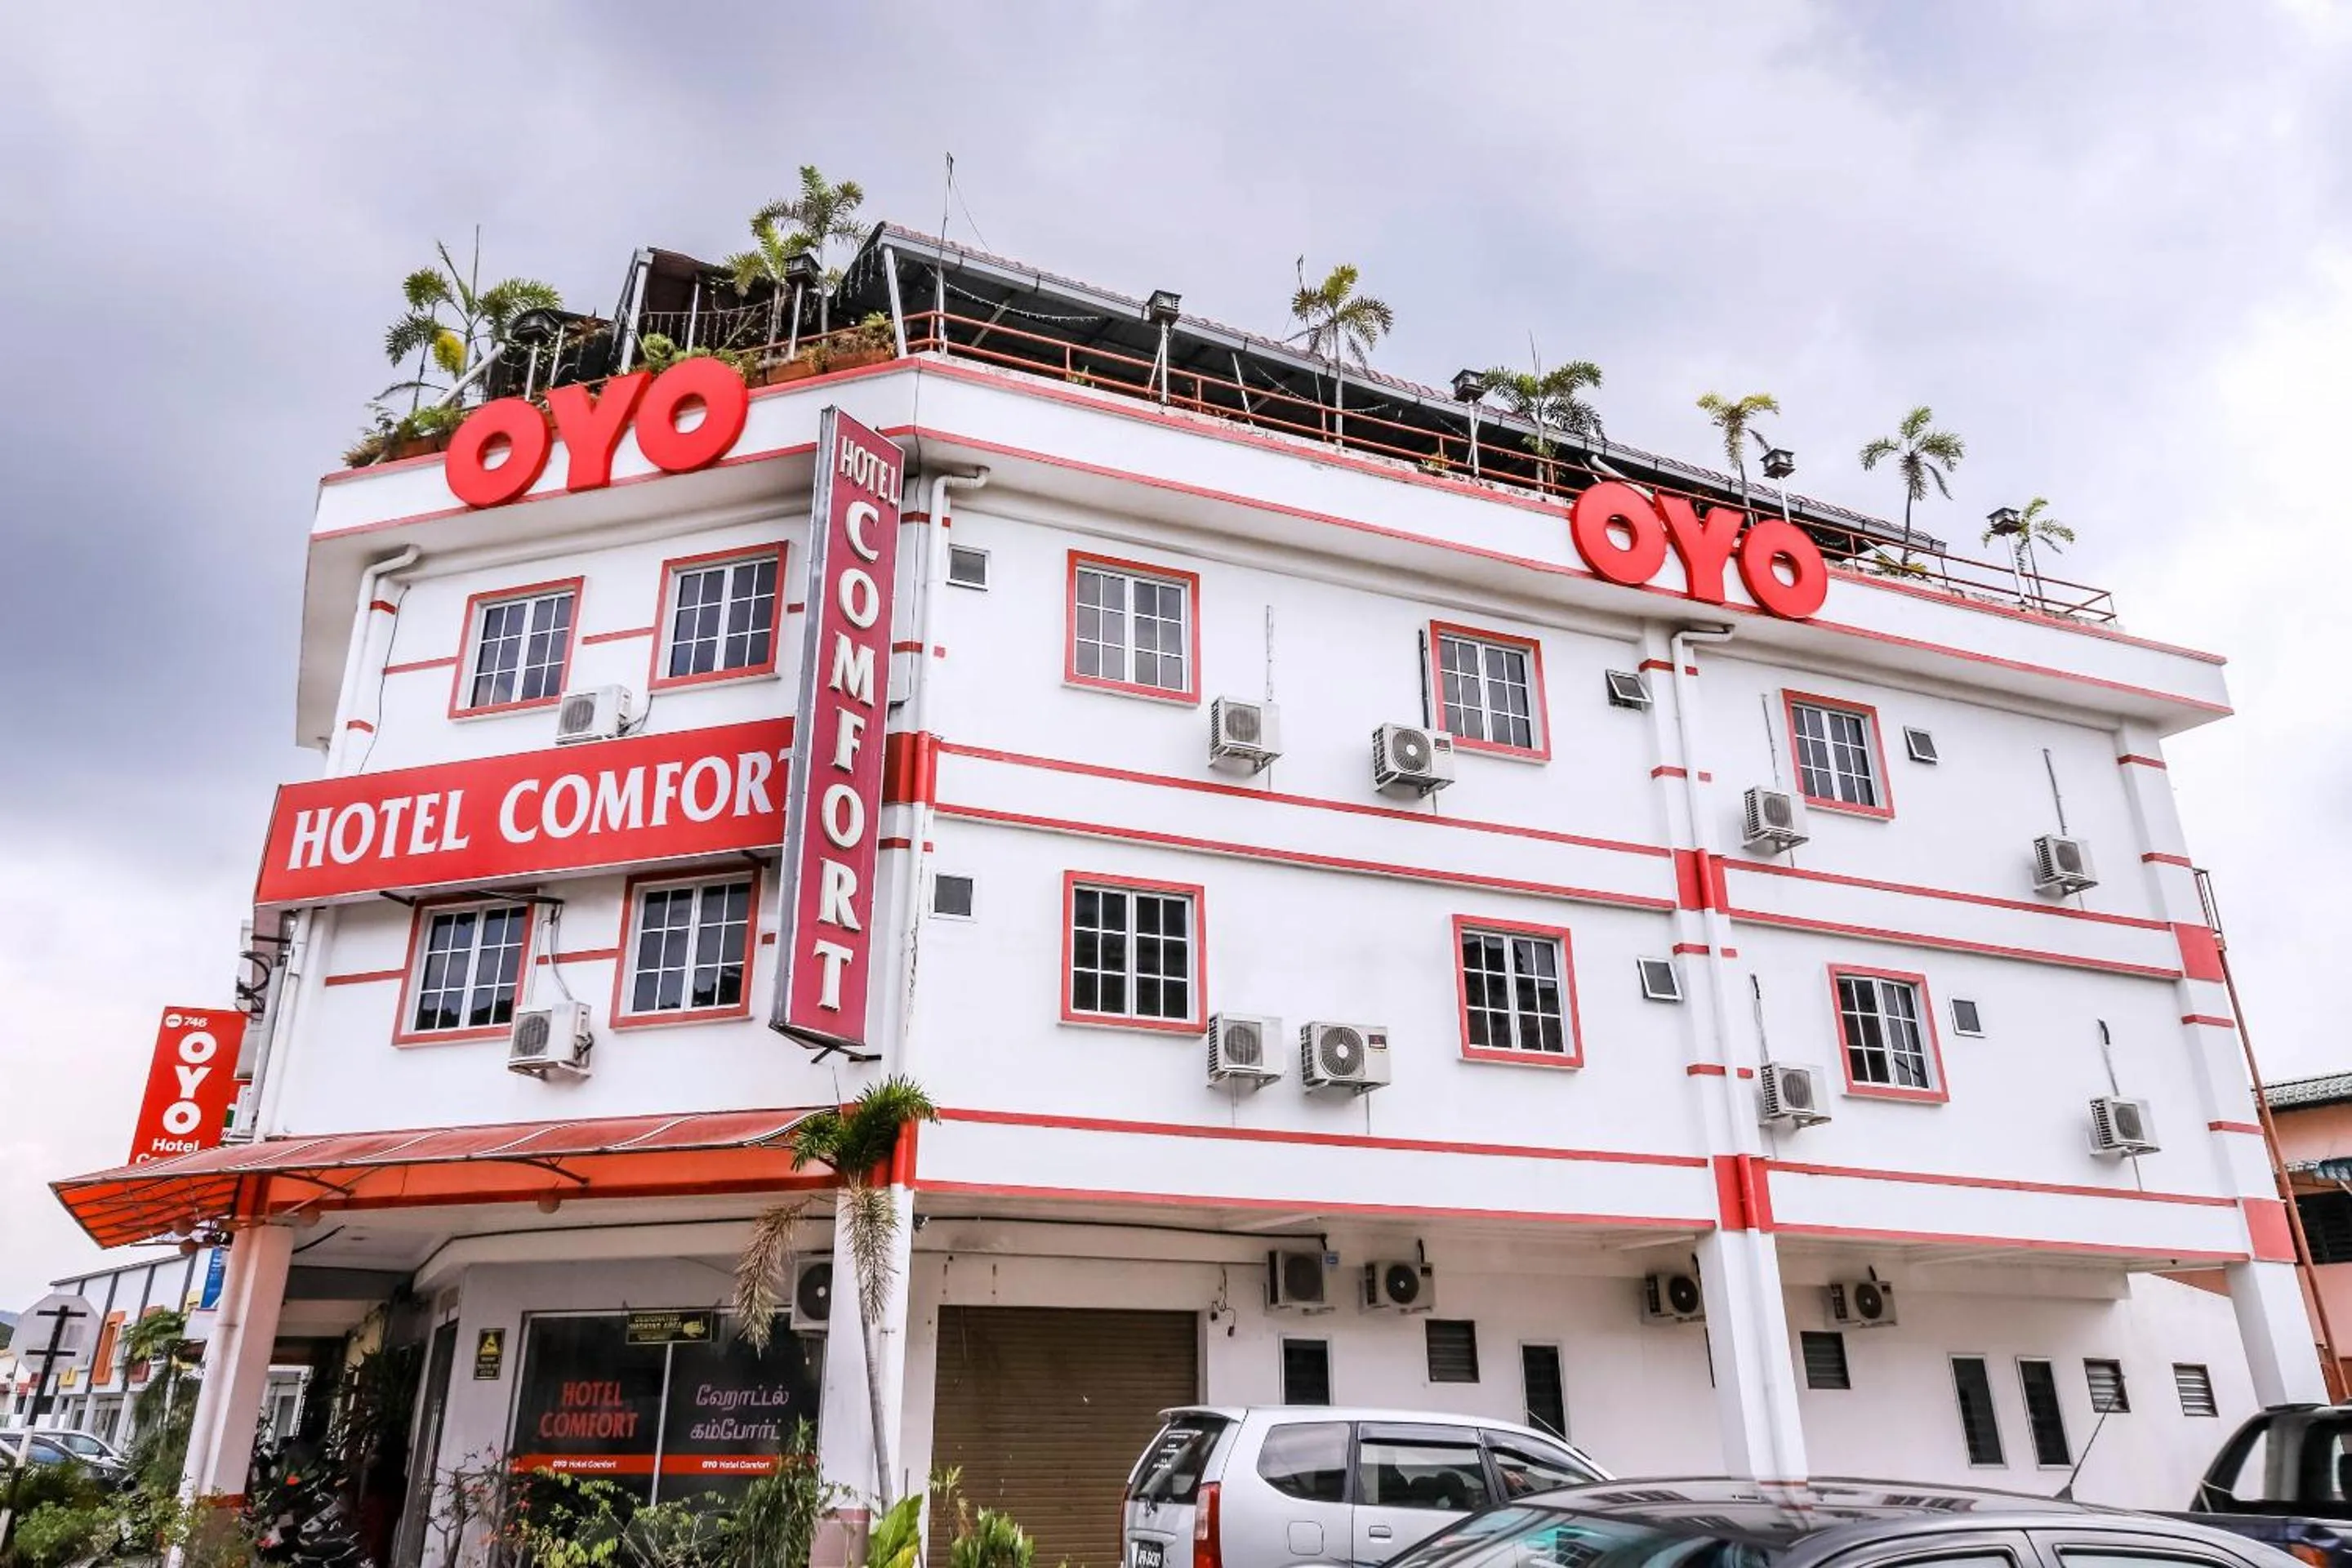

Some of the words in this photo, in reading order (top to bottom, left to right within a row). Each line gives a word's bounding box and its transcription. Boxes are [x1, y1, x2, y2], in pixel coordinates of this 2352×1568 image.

[445, 356, 750, 508] OYO
[838, 435, 899, 506] HOTEL
[1570, 480, 1828, 620] OYO
[813, 501, 880, 1012] COMFORT
[287, 789, 471, 870] HOTEL
[163, 1031, 217, 1134] OYO
[151, 1138, 199, 1152] Hotel
[540, 1412, 639, 1438] COMFORT
[562, 1380, 623, 1406] HOTEL
[553, 1460, 568, 1468] OYO
[569, 1460, 586, 1468] Hotel
[588, 1460, 617, 1468] Comfort
[702, 1460, 717, 1468] OYO
[719, 1460, 738, 1468] Hotel
[740, 1460, 769, 1468] Comfort
